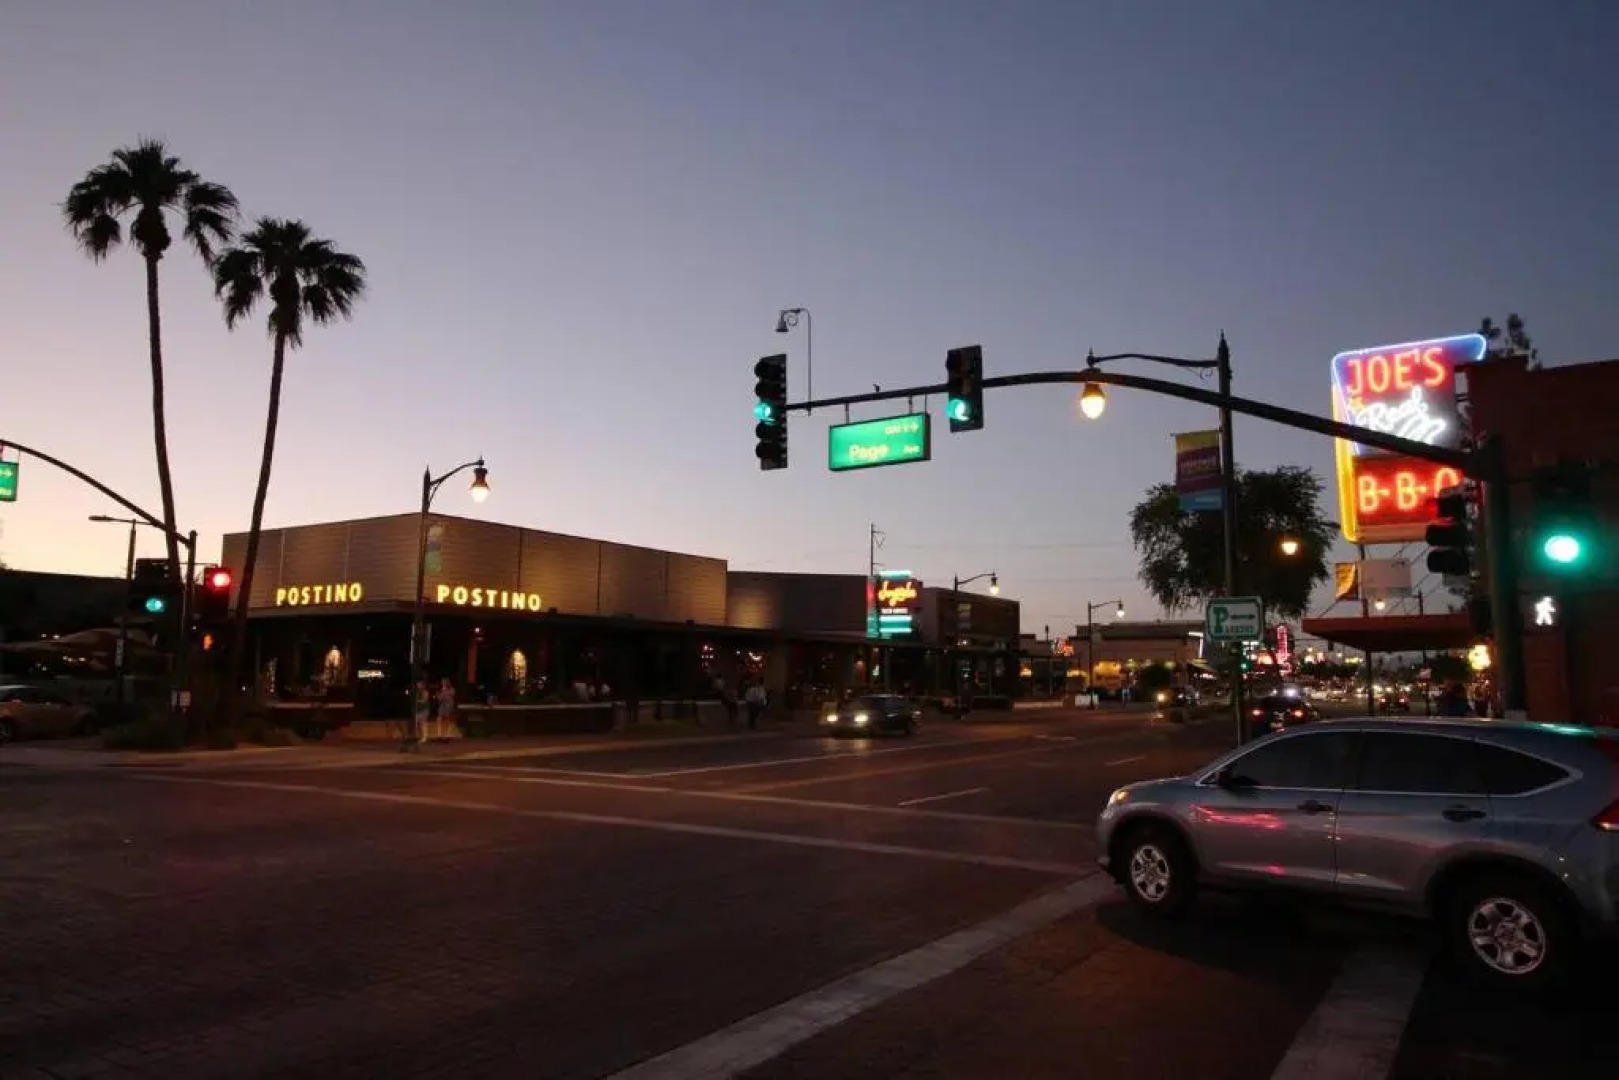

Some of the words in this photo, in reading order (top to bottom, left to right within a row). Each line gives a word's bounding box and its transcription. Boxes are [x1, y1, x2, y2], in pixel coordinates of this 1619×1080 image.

[1347, 347, 1446, 395] JOE'S
[276, 583, 362, 606] POSTINO
[437, 585, 541, 611] POSTINO
